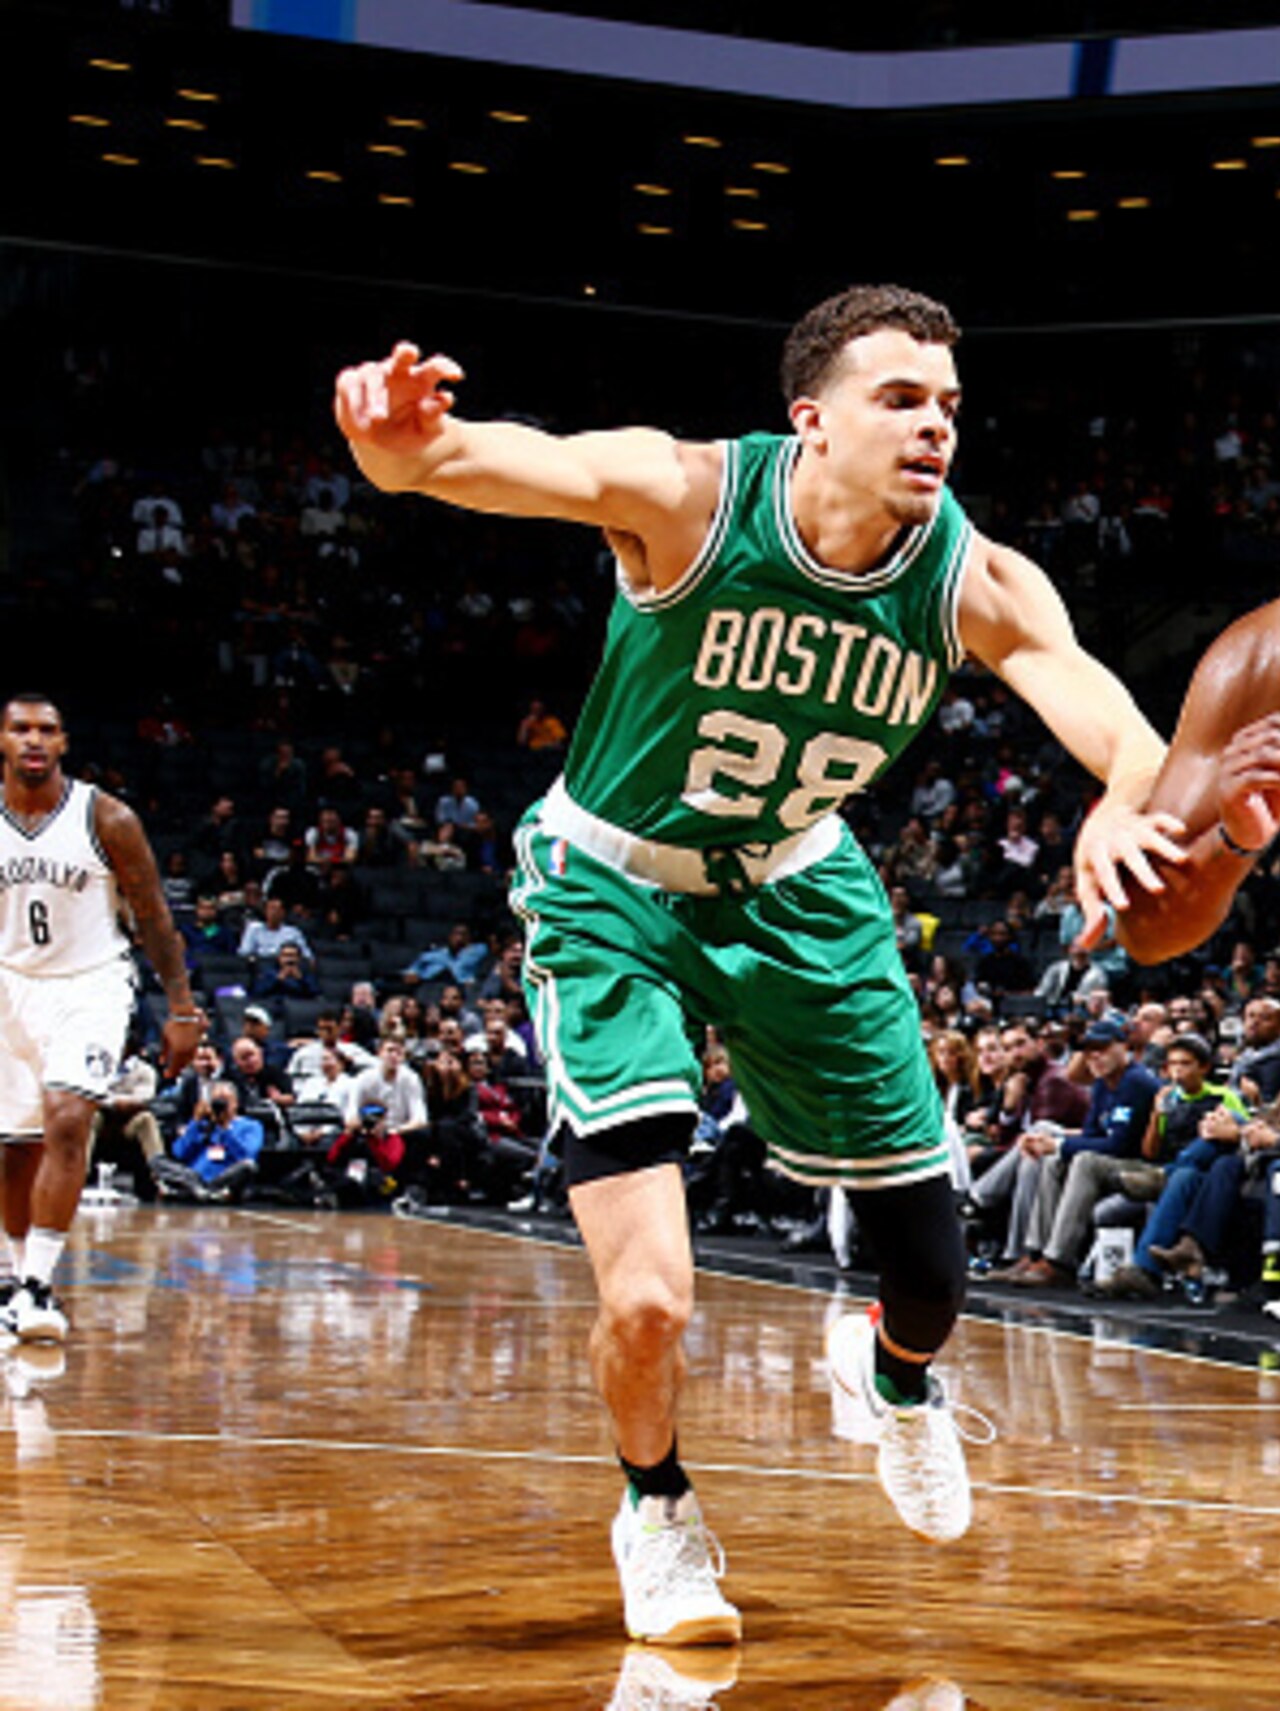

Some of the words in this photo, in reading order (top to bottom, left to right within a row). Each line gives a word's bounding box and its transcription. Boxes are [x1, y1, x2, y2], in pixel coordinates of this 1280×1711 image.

[693, 607, 937, 726] BOSTON
[681, 709, 889, 830] 28
[29, 900, 52, 946] 6
